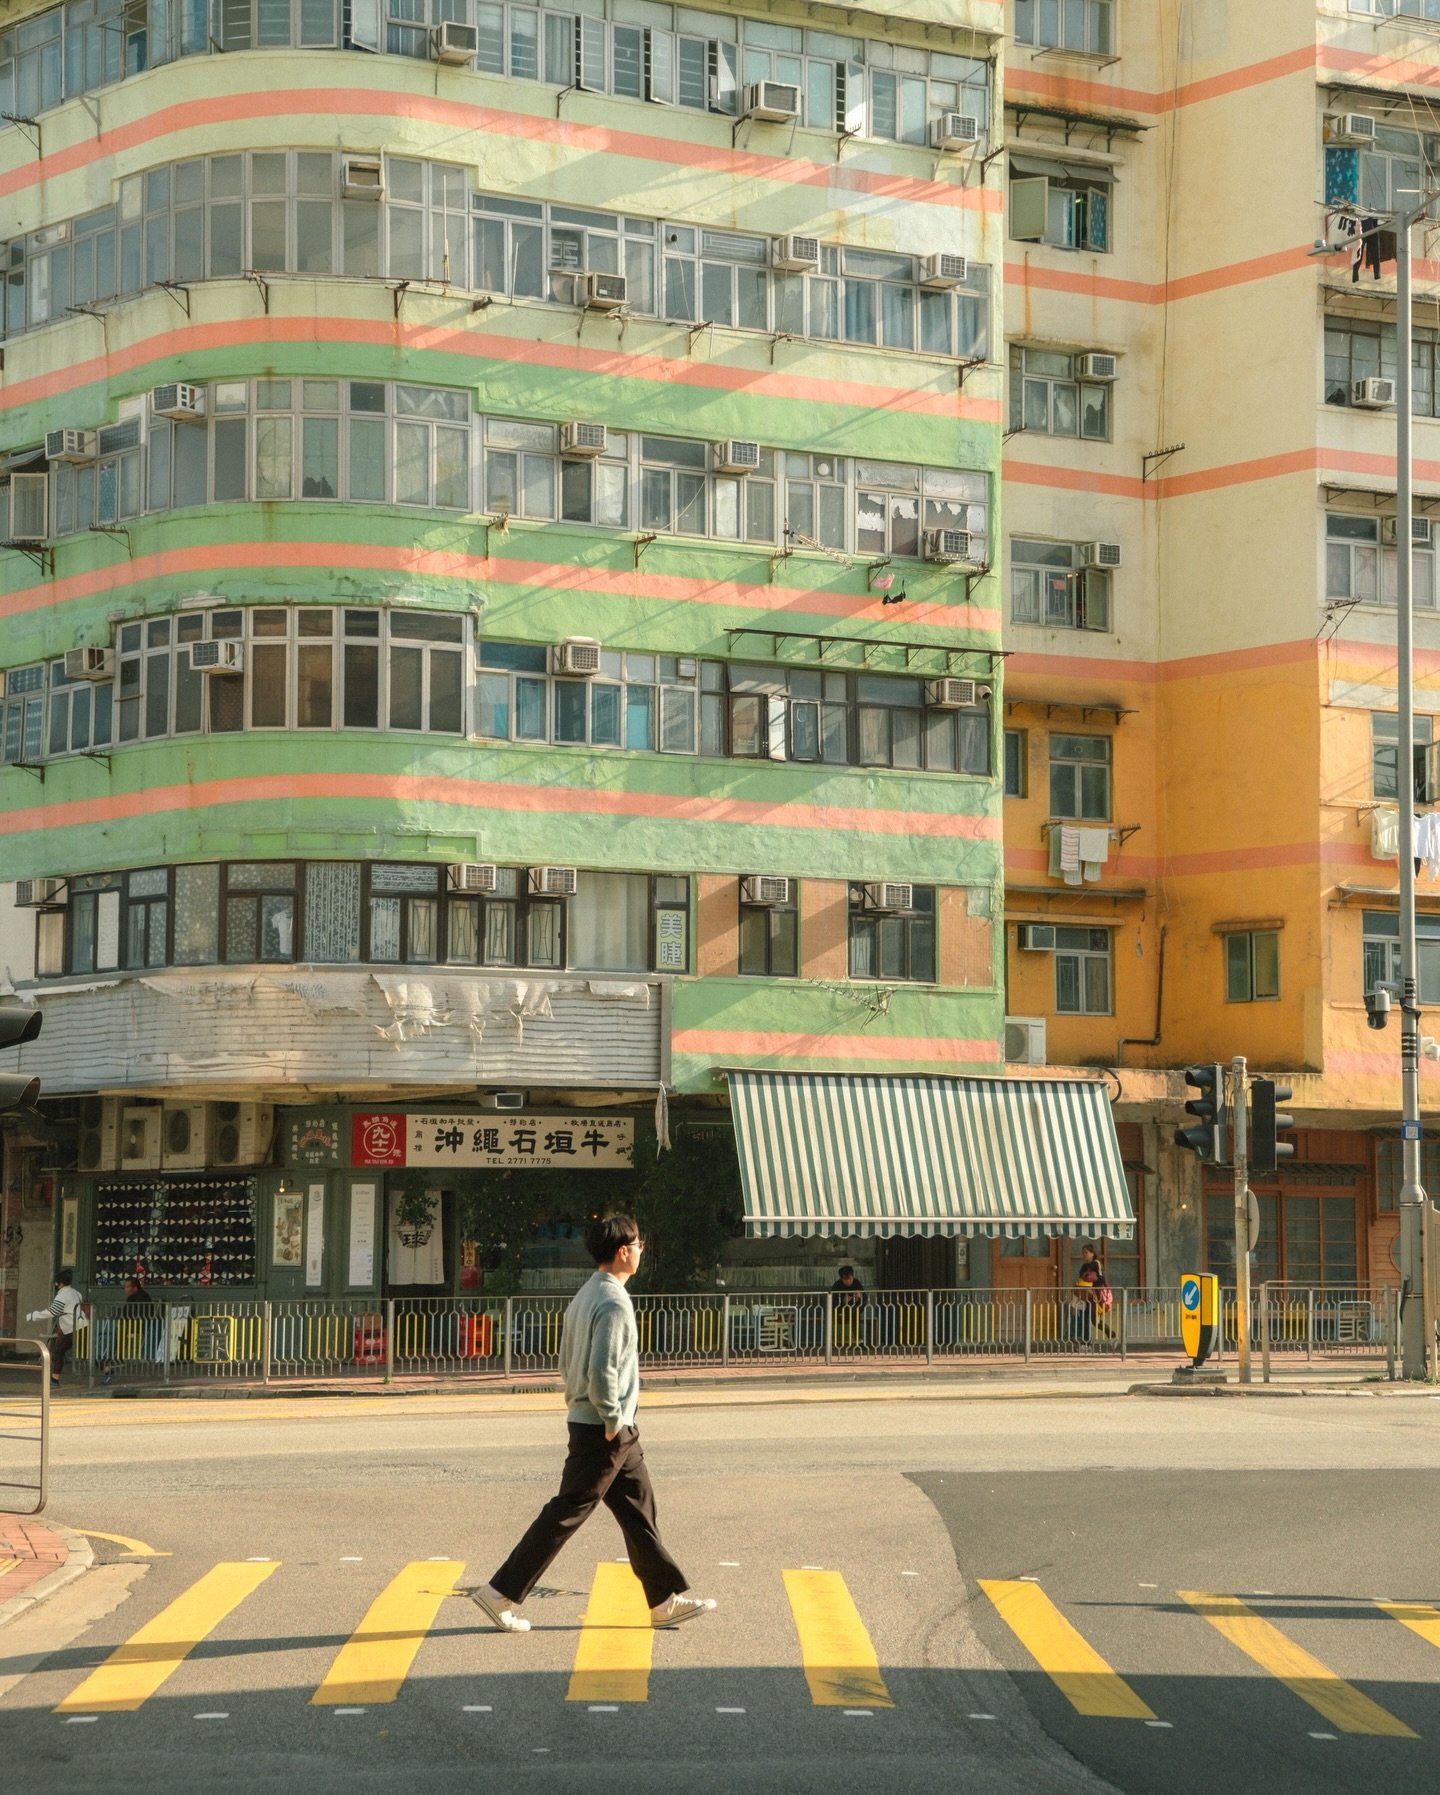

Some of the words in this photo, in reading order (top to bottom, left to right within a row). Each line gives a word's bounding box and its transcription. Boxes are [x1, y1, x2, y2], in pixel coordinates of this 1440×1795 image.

[660, 913, 683, 967] 美睫
[371, 1126, 391, 1153] 九十一
[434, 1126, 610, 1158] 沖繩石垣牛
[486, 1157, 504, 1165] TEL
[507, 1157, 527, 1165] 2771
[530, 1157, 552, 1165] 7775
